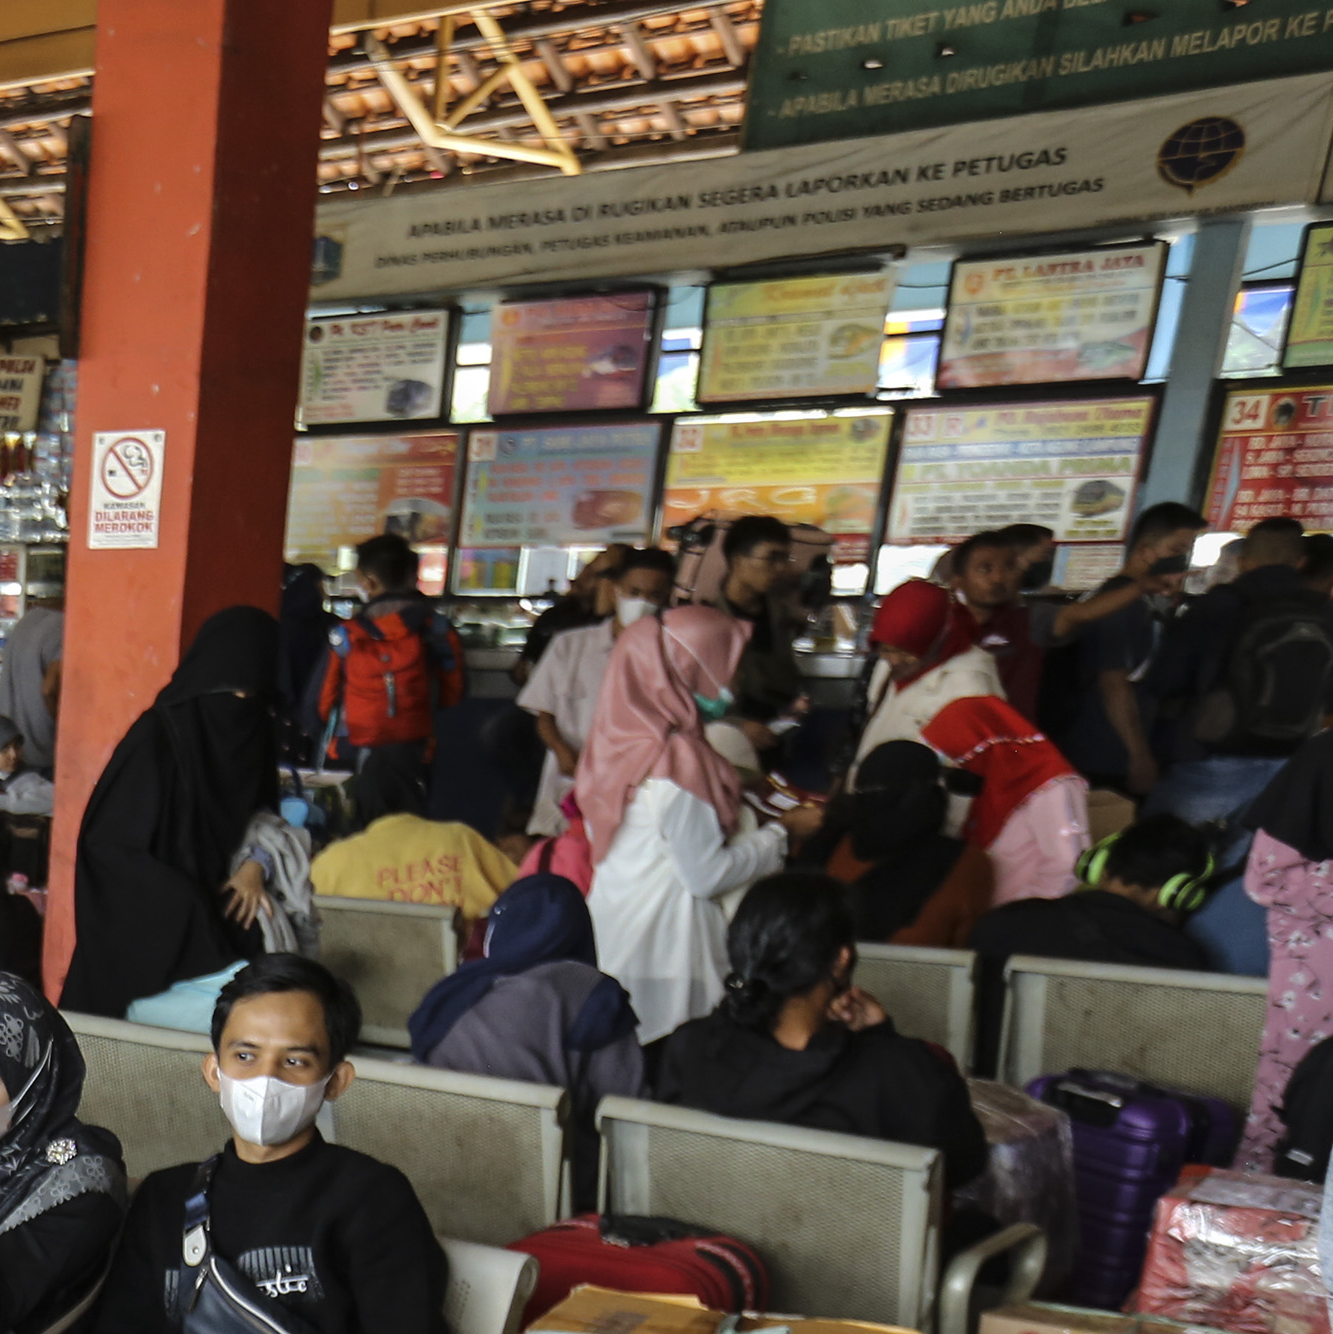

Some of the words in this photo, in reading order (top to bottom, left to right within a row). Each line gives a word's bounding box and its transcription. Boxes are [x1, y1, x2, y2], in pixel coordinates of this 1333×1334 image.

[787, 22, 881, 54] PASTIKAN
[885, 12, 939, 40] TIKET
[943, 2, 998, 31] YANG
[862, 76, 942, 106] MERASA
[944, 54, 1055, 95] DIRUGIKAN
[1058, 35, 1167, 76] SILAHKAN
[1169, 18, 1280, 57] MELAPOR
[1284, 10, 1320, 39] KE
[406, 215, 484, 240] APABILA
[487, 204, 569, 230] MERASA
[597, 194, 691, 220] RUGIKAN
[697, 182, 779, 209] SEGERA
[783, 166, 912, 199] LAPORKAN
[915, 161, 946, 184] KE
[951, 146, 1068, 179] PETUGAS
[542, 233, 611, 254] PETUGAS
[801, 206, 856, 228] POLISI
[862, 200, 913, 219] YANG
[915, 191, 994, 214] SEDANG
[998, 177, 1106, 205] BERTUGAS
[1233, 400, 1261, 425] 34
[94, 510, 155, 523] DILARANG
[94, 522, 154, 534] MEROKOK
